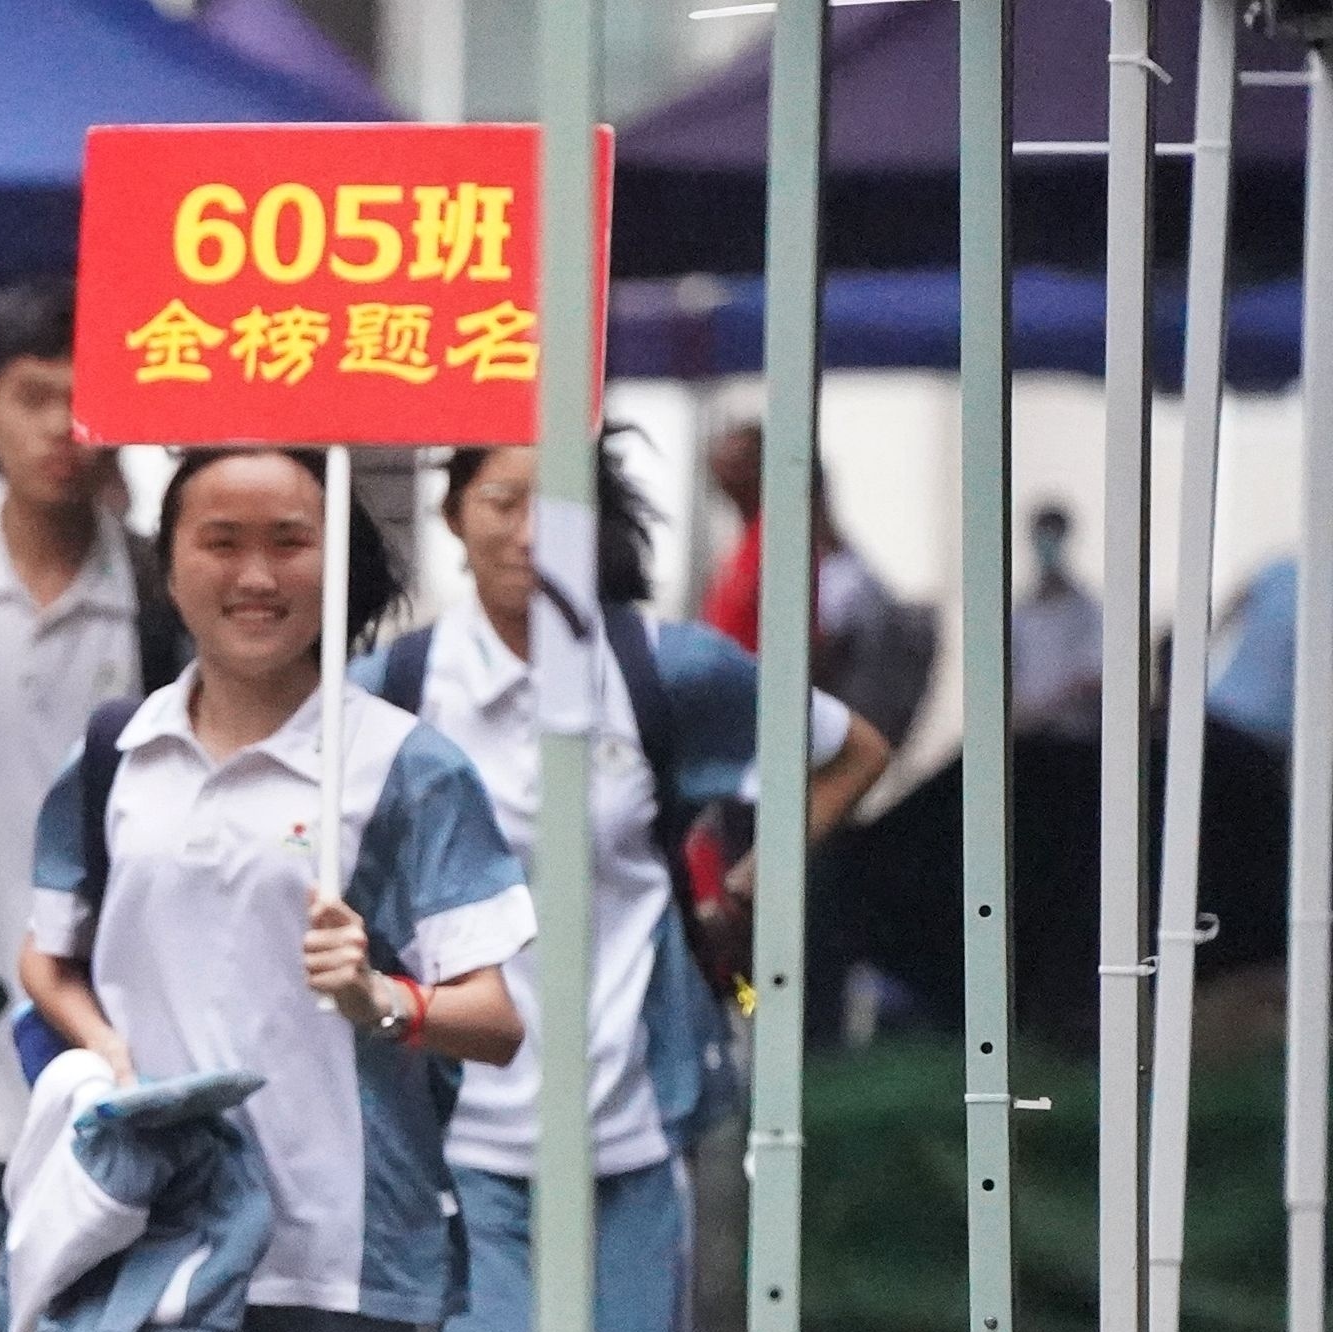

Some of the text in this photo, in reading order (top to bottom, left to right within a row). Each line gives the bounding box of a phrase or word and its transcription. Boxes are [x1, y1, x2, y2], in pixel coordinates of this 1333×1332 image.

[173, 181, 515, 285] 605班
[125, 297, 541, 387] 金榜题名
